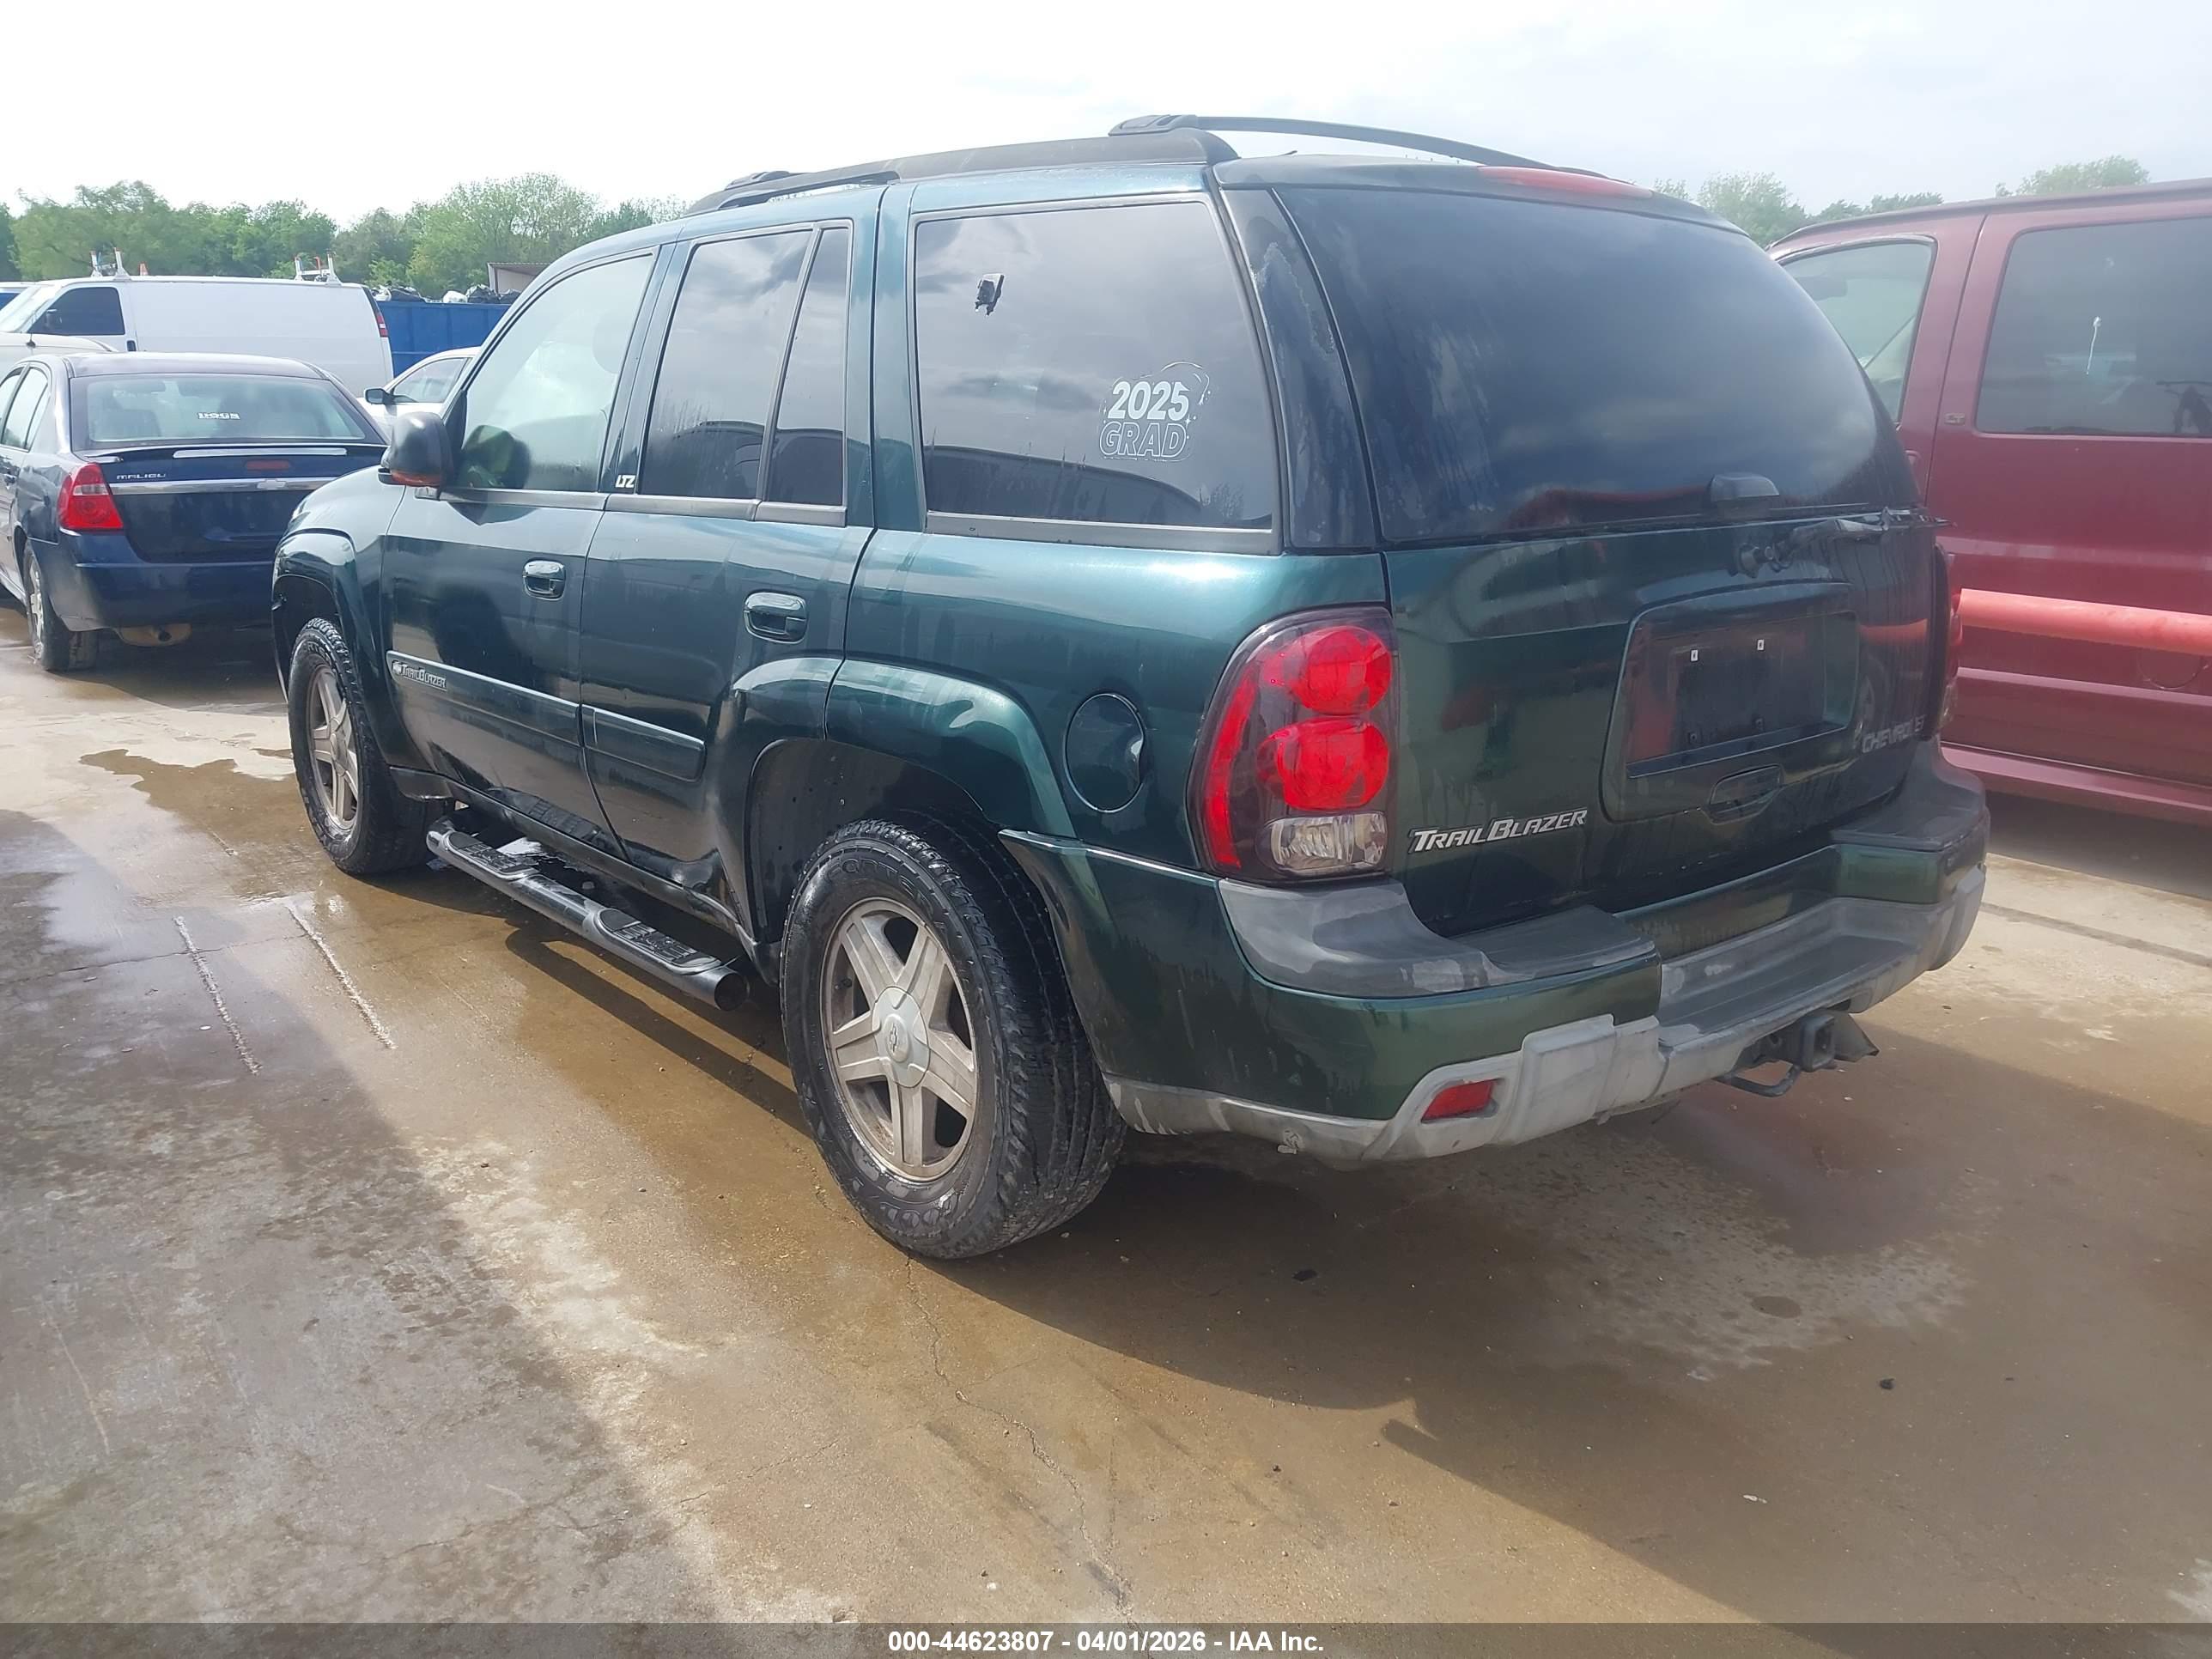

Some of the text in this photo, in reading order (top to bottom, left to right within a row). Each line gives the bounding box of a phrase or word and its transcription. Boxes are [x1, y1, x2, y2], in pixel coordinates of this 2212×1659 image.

[1107, 380, 1190, 422] 2025
[1099, 421, 1187, 458] GRAD
[615, 474, 636, 488] LTZ
